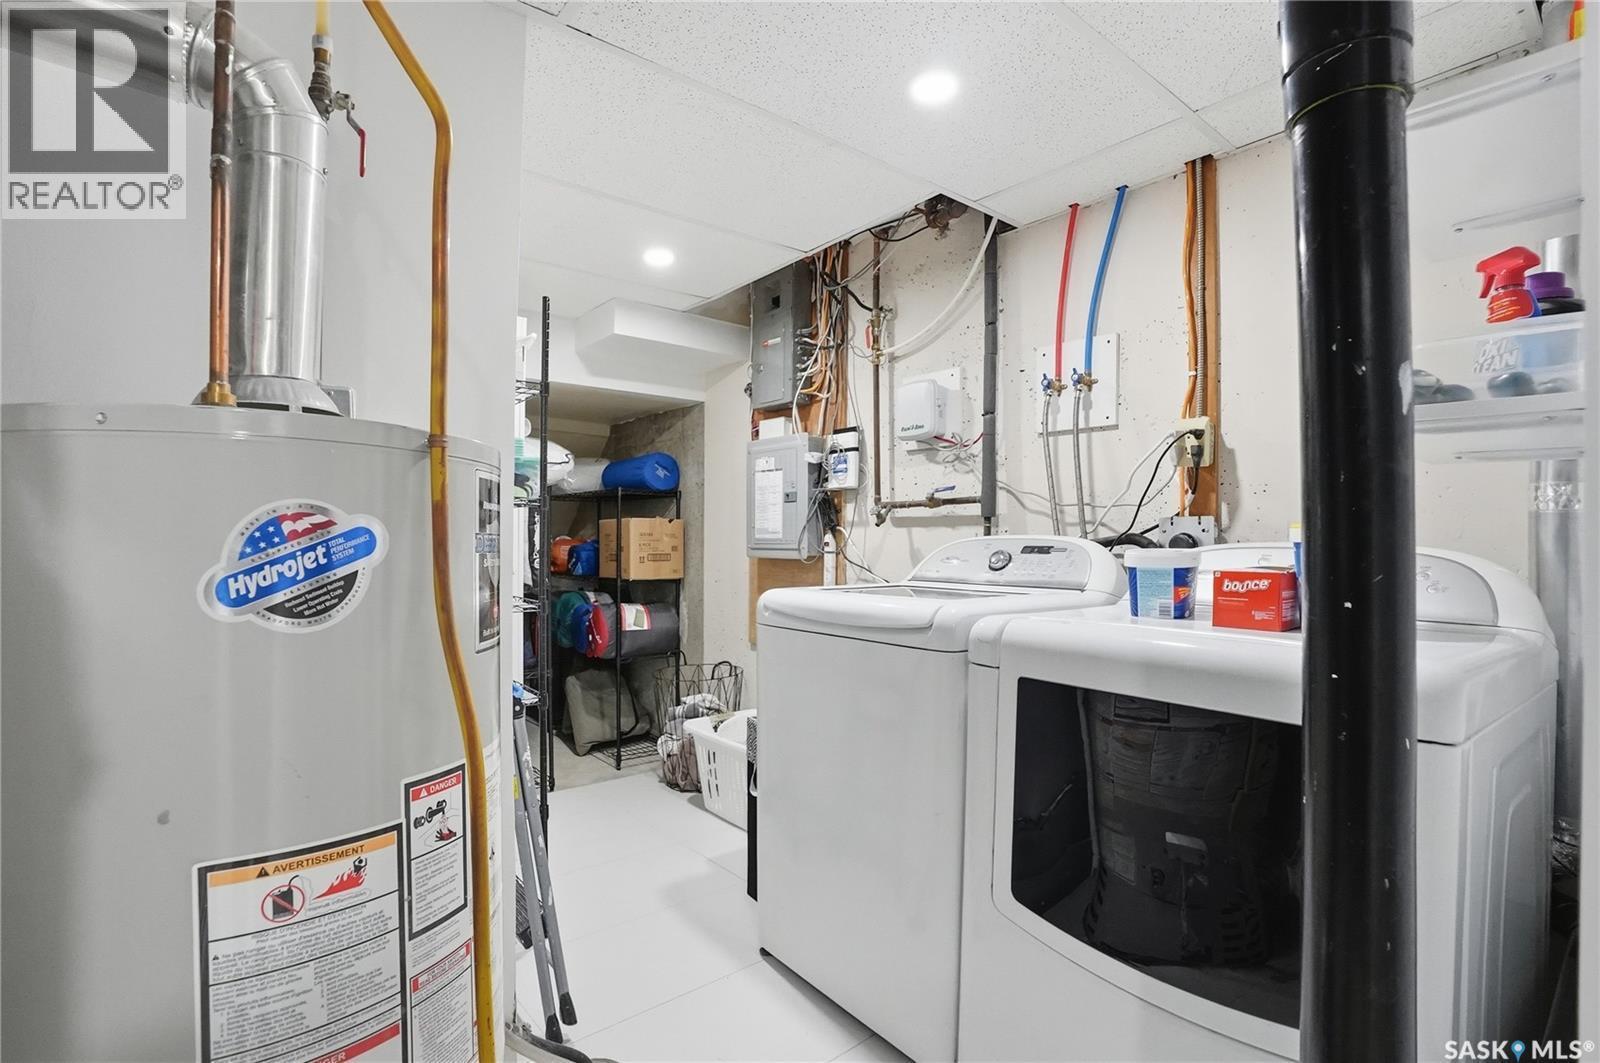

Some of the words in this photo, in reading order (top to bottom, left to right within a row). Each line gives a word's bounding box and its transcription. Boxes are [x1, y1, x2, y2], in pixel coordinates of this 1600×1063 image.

[328, 536, 346, 548] TOTAL
[332, 547, 355, 561] SYSTEM
[227, 544, 328, 600] Hydrojet
[1223, 578, 1269, 593] bounce
[429, 776, 457, 795] DANGER
[272, 845, 366, 874] AVERTISSEMENT
